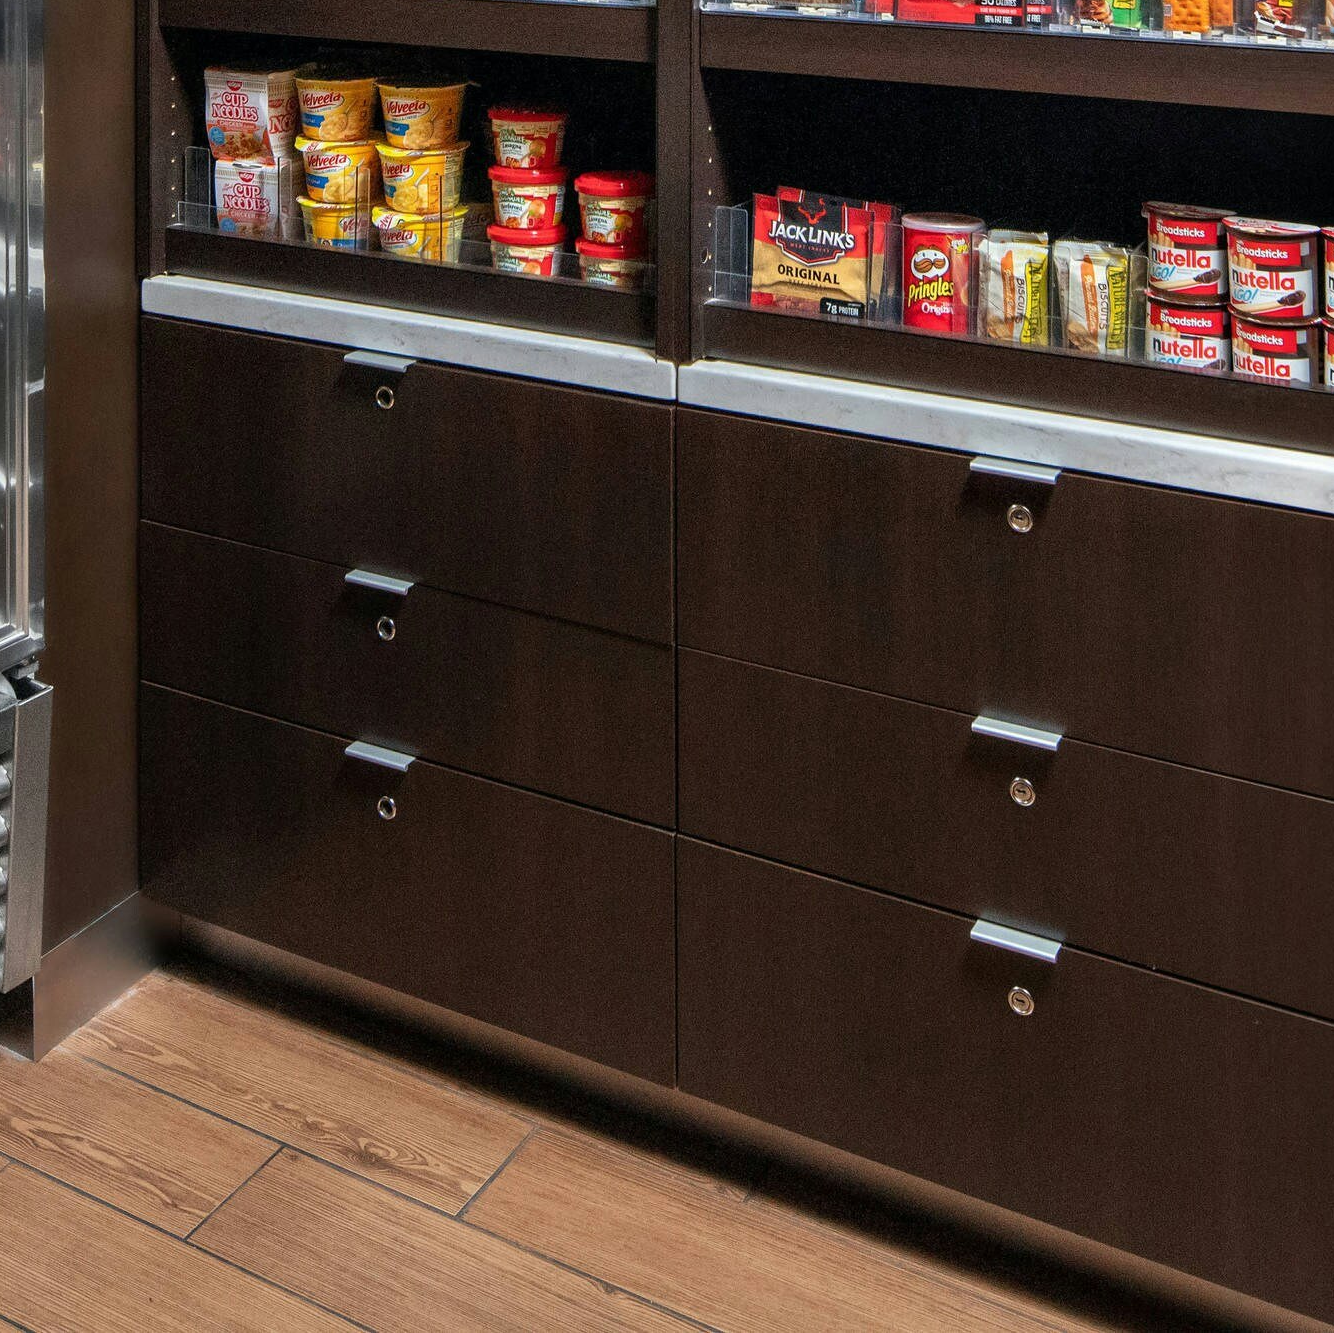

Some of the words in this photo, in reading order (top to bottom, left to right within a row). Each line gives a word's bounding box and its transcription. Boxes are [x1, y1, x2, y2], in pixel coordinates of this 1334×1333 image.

[222, 92, 248, 107] CUP
[301, 91, 343, 108] Velveeta
[212, 104, 259, 123] NOODLES
[307, 153, 348, 168] Velveeta
[232, 183, 261, 199] CUP
[767, 218, 810, 243] JACK
[808, 225, 855, 251] LINK'S
[1155, 222, 1206, 238] Breadsticks
[1151, 247, 1211, 269] nutella
[1235, 244, 1289, 260] Breadsticks
[777, 263, 840, 285] ORIGINAL
[1231, 269, 1296, 291] nutella
[907, 279, 954, 305] Pringles
[825, 303, 838, 314] 7g
[1098, 282, 1108, 330] BISCUITS
[1159, 313, 1213, 328] Breadsticks
[1235, 328, 1285, 347] Breadsticks
[1152, 336, 1218, 359] nutella
[1232, 351, 1292, 379] nutella
